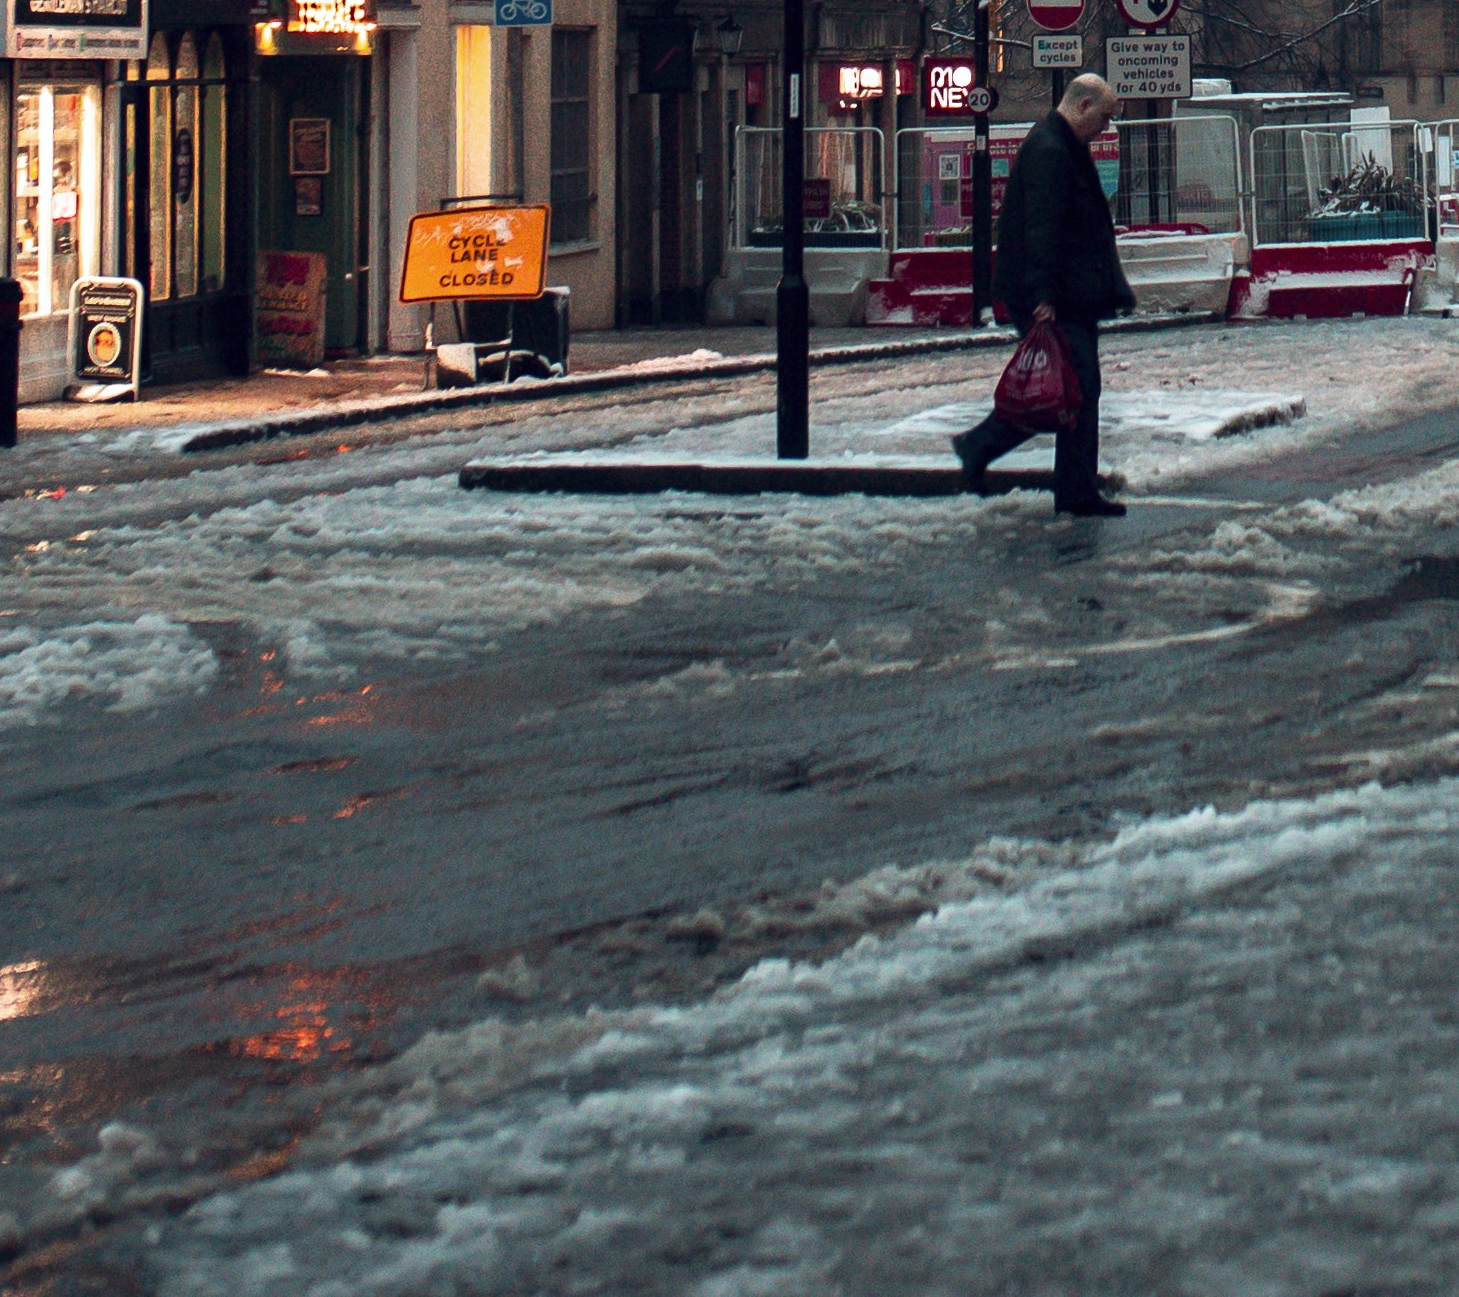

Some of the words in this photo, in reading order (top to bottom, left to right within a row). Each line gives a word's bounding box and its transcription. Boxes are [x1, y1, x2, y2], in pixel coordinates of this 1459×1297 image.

[1037, 40, 1078, 51] Except
[1111, 41, 1139, 53] Give
[1143, 43, 1168, 54] way
[1173, 41, 1185, 52] to
[1039, 52, 1076, 64] cycles
[1118, 54, 1179, 67] oncoming
[1123, 67, 1174, 80] vehicles
[1116, 82, 1134, 94] for
[1138, 81, 1157, 93] 40
[1160, 81, 1182, 96] yds
[969, 93, 990, 106] 20
[451, 249, 499, 263] LANE
[439, 271, 514, 287] CLOSED
